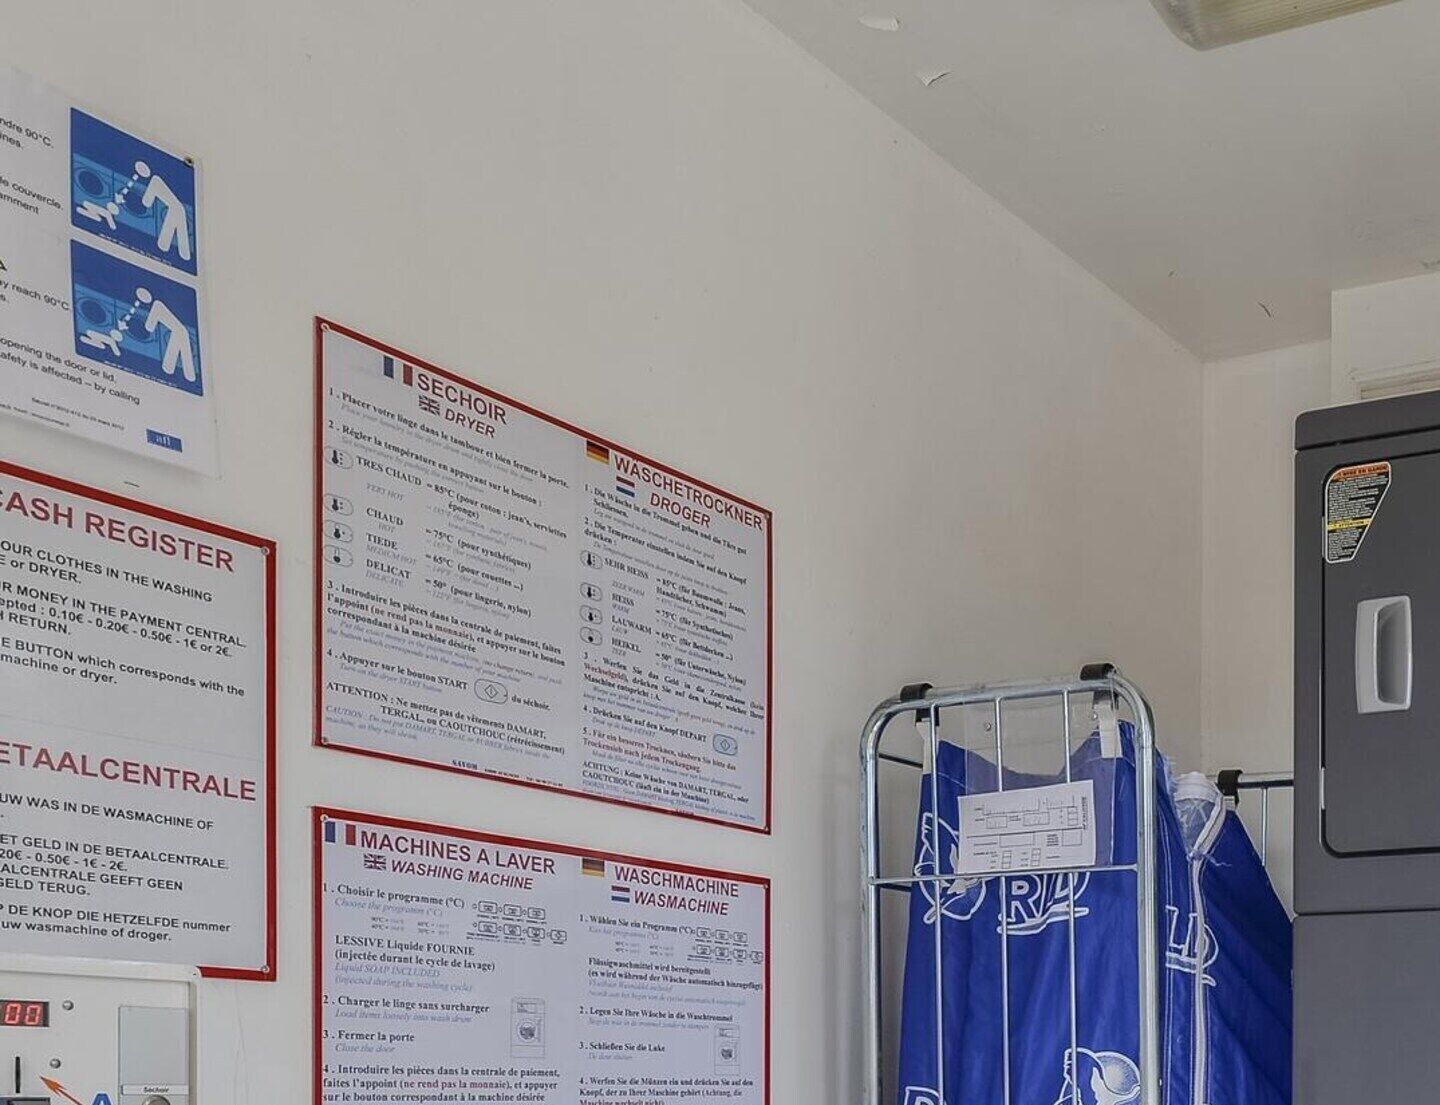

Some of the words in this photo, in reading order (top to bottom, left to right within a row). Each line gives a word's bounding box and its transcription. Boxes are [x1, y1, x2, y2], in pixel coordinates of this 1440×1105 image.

[12, 284, 40, 300] reach
[45, 352, 61, 364] the
[64, 359, 86, 372] door
[90, 368, 100, 376] or
[41, 364, 82, 385] affected
[95, 383, 106, 394] by
[109, 388, 140, 405] calling
[417, 373, 507, 425] SECHOIR
[445, 408, 496, 439] DRYER
[385, 466, 422, 486] CHAUD
[366, 507, 404, 526] CHAUD
[650, 493, 711, 528] DROGER
[85, 511, 234, 573] REGISTER
[11, 560, 25, 569] or
[29, 562, 82, 584] DRYER.
[37, 550, 102, 575] CLOTHES
[106, 567, 119, 579] IN
[123, 571, 149, 587] THE
[152, 578, 213, 603] WASHING
[366, 559, 411, 580] DELICAT
[9, 613, 71, 635] RETURN.
[16, 586, 68, 605] MONEY
[73, 597, 85, 610] IN
[90, 602, 116, 616] THE
[120, 609, 182, 632] PAYMENT
[186, 625, 247, 648] CENTRAL.
[49, 607, 84, 624] 0.10€
[96, 618, 129, 634] 0.20€
[140, 627, 172, 643] 0.50€
[184, 638, 197, 650] 1€
[200, 643, 212, 653] or
[1, 654, 59, 672] machine
[63, 666, 75, 675] or
[80, 668, 118, 685] dryer.
[16, 639, 73, 661] BUTTON
[78, 654, 115, 670] which
[119, 663, 196, 687] corresponds
[200, 679, 223, 692] with
[227, 684, 245, 697] the
[438, 676, 468, 691] START
[26, 798, 60, 810] WAS
[63, 802, 77, 812] IN
[81, 804, 99, 815] DE
[103, 806, 193, 829] WASMACHINE
[197, 820, 213, 831] OF
[23, 837, 61, 850] GELD
[66, 841, 78, 851] IN
[84, 844, 101, 854] DE
[361, 831, 471, 862] MACHINES
[477, 849, 489, 864] A
[496, 852, 555, 874] LAVER
[35, 852, 70, 865] 0.50€
[84, 857, 97, 868] 1€
[100, 874, 144, 887] GEEFT
[147, 878, 183, 891] GEEN
[392, 860, 463, 881] WASHING
[468, 871, 534, 890] MACHINE
[615, 866, 739, 898] WASCHMACHINE
[38, 881, 90, 895] TERUG.
[338, 884, 374, 898] Choisir
[377, 889, 385, 898] le
[388, 892, 444, 905] programme
[634, 891, 729, 916] WASMACHINE
[9, 904, 28, 916] DE
[33, 906, 72, 920] KNOP
[77, 910, 99, 921] DIE
[103, 913, 179, 928] HETZELFDE
[183, 920, 230, 932] nummer
[2, 921, 21, 930] uw
[26, 922, 107, 937] wasmachine
[112, 927, 124, 937] of
[128, 929, 172, 941] droger.
[335, 936, 384, 948] LESSIVE
[387, 940, 423, 952] Liquide
[427, 943, 475, 956] FOURNIE
[380, 954, 412, 963] durant
[416, 957, 424, 965] le
[426, 957, 447, 969] cycle
[451, 960, 461, 968] de
[464, 960, 495, 971] lavage)
[338, 996, 380, 1009] Charger
[383, 999, 391, 1007] le
[393, 1000, 415, 1011] linge
[441, 1004, 489, 1014] surcharger
[338, 1031, 373, 1040] Fermer
[377, 1032, 386, 1040] la
[389, 1034, 414, 1043] porte
[338, 1065, 388, 1074] Introduire
[392, 1066, 404, 1074] les
[438, 1067, 459, 1075] dans
[461, 1067, 468, 1075] la
[471, 1068, 506, 1076] centrale
